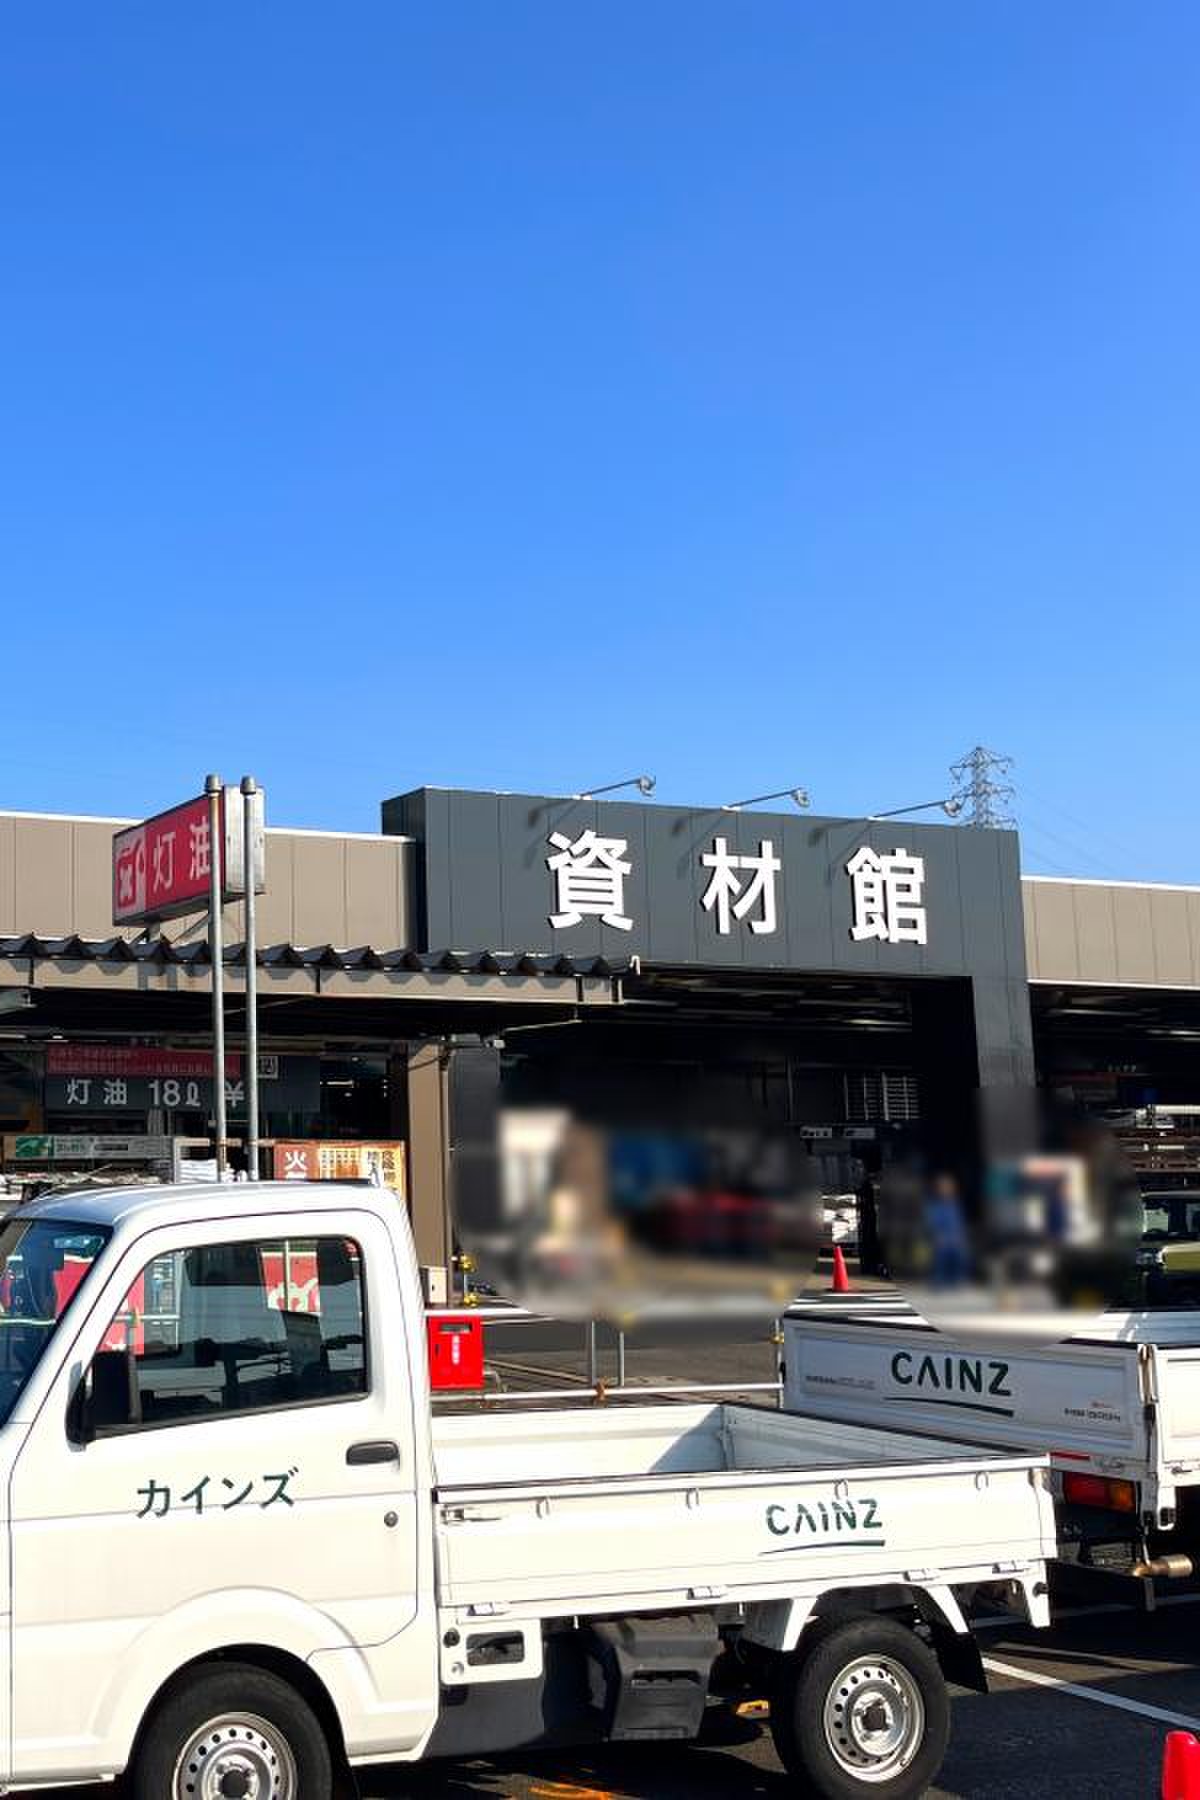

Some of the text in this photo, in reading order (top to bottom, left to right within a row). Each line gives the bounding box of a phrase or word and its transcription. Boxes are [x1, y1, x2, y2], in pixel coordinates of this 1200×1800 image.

[547, 830, 928, 945] 資材館
[66, 1079, 128, 1105] 灯油
[890, 1351, 1012, 1397] CAINZ
[136, 1466, 300, 1519] カインズ
[765, 1497, 883, 1536] CAINZ
